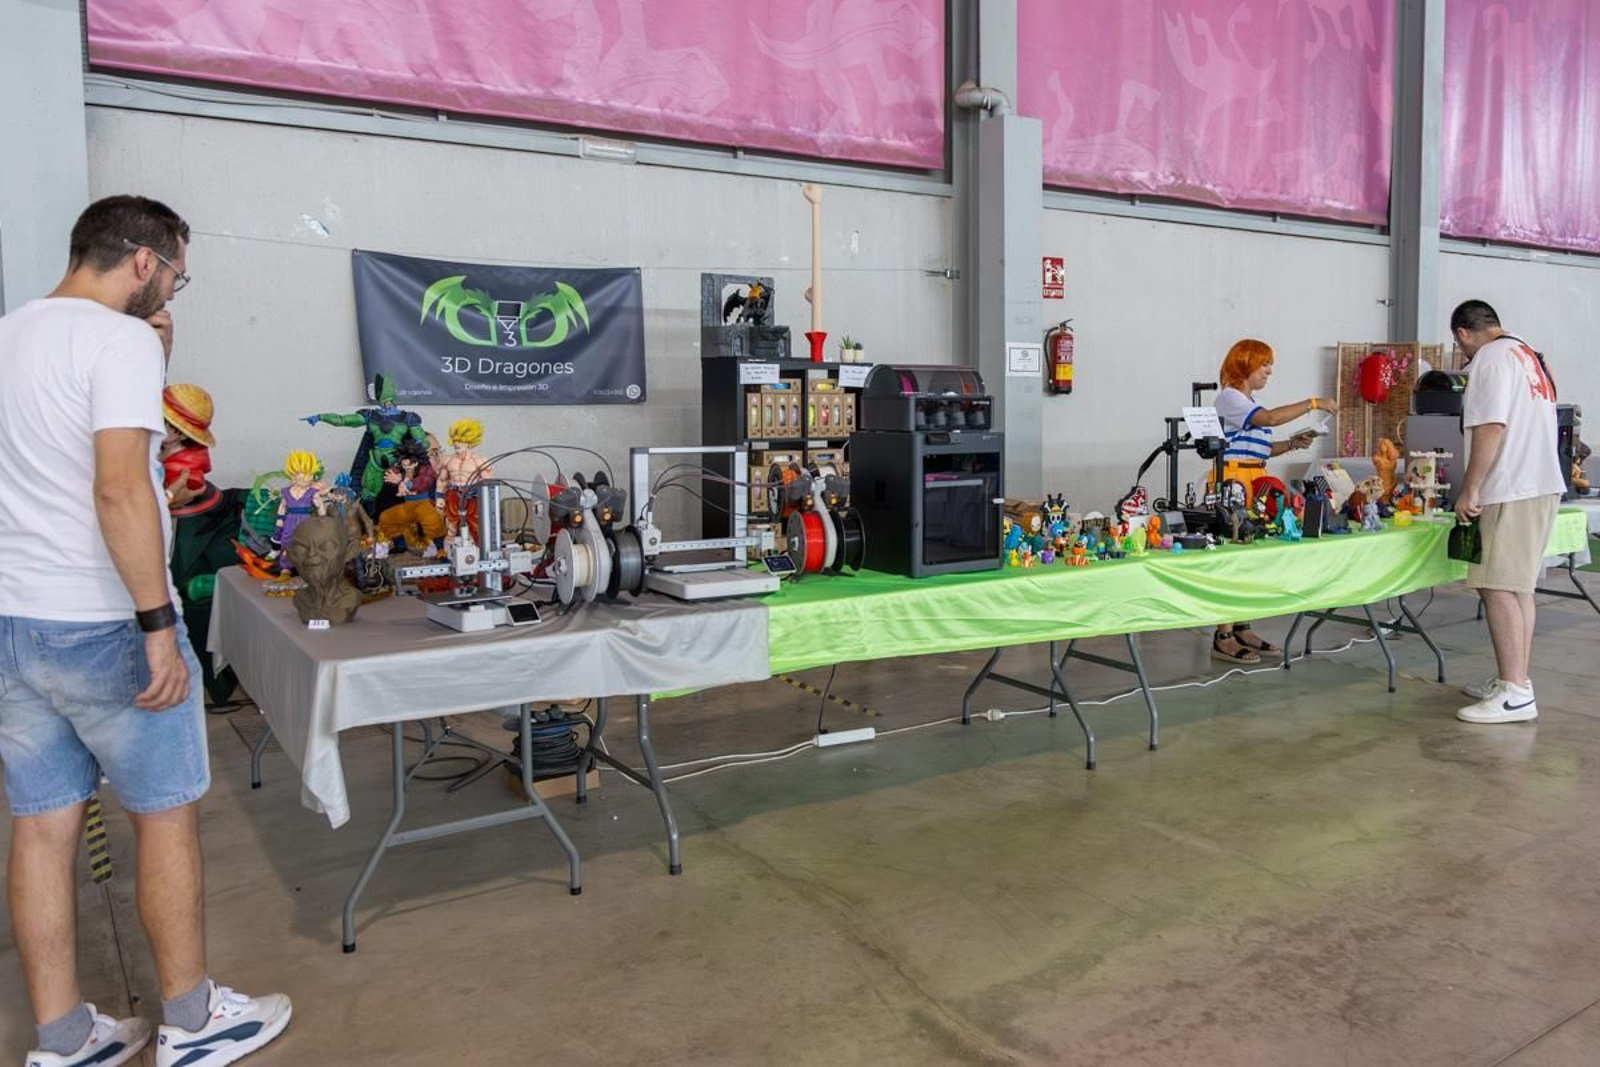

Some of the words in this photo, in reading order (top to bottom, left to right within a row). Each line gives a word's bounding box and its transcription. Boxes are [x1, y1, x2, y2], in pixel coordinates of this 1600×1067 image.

[440, 356, 471, 373] 3D
[478, 358, 574, 378] Dragones
[537, 383, 549, 391] 3D
